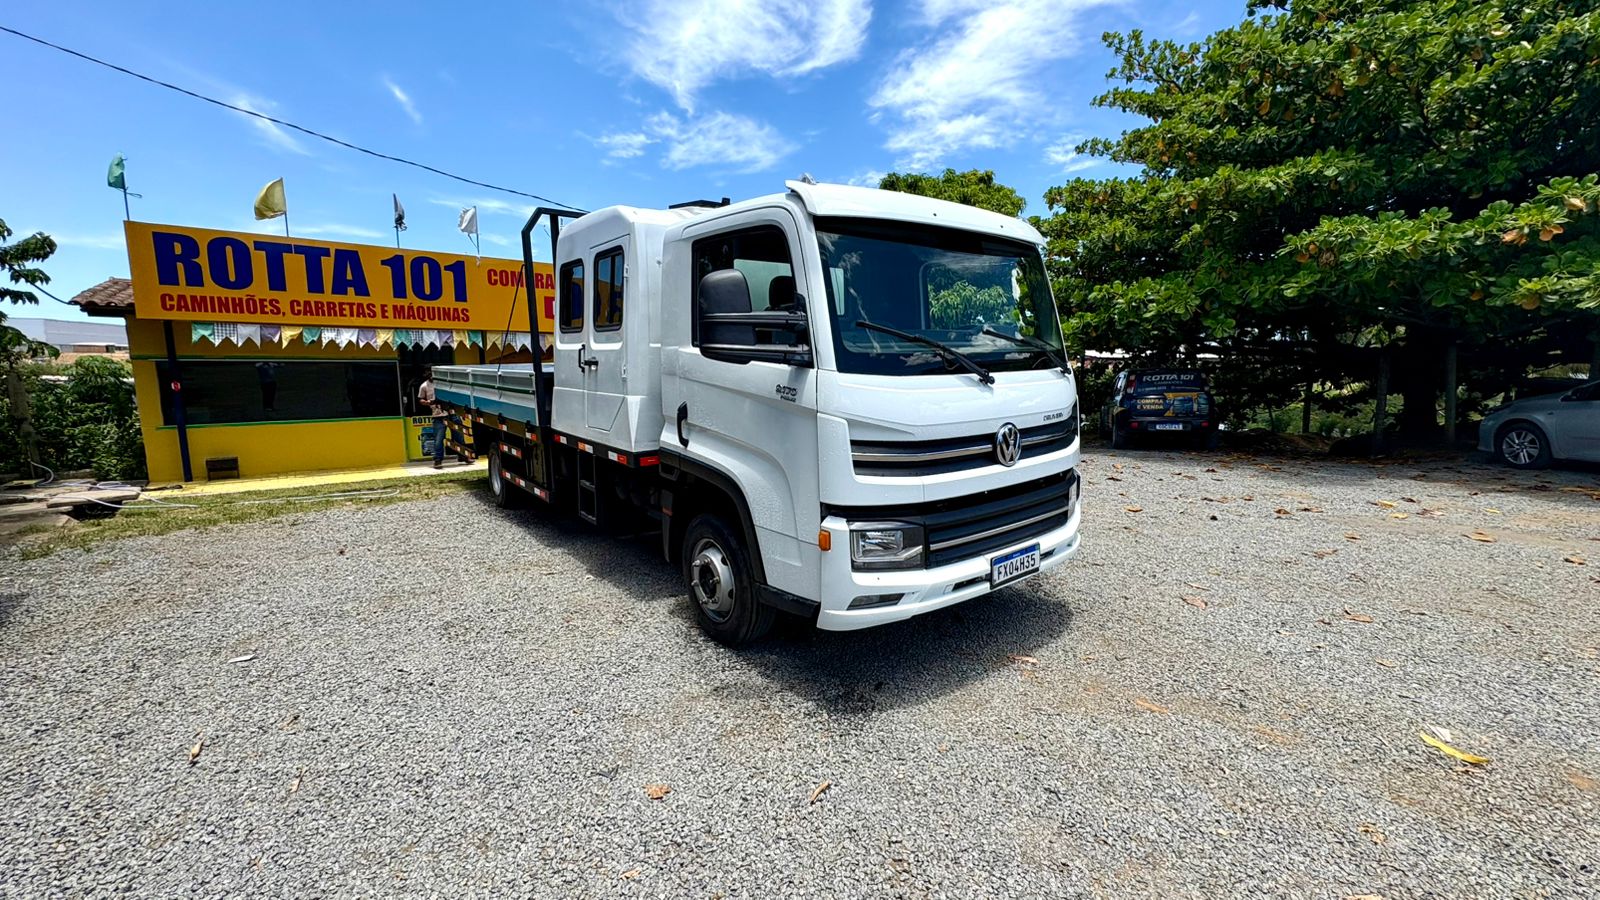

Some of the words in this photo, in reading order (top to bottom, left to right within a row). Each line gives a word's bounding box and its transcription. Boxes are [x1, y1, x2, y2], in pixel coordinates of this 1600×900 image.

[152, 231, 371, 297] ROTTA
[380, 253, 468, 303] 101
[487, 268, 555, 289] COMRA
[160, 293, 286, 317] CAMINHÕES,
[289, 299, 377, 319] CARRETAS
[381, 304, 389, 319] E
[392, 302, 470, 323] MÁQUINAS
